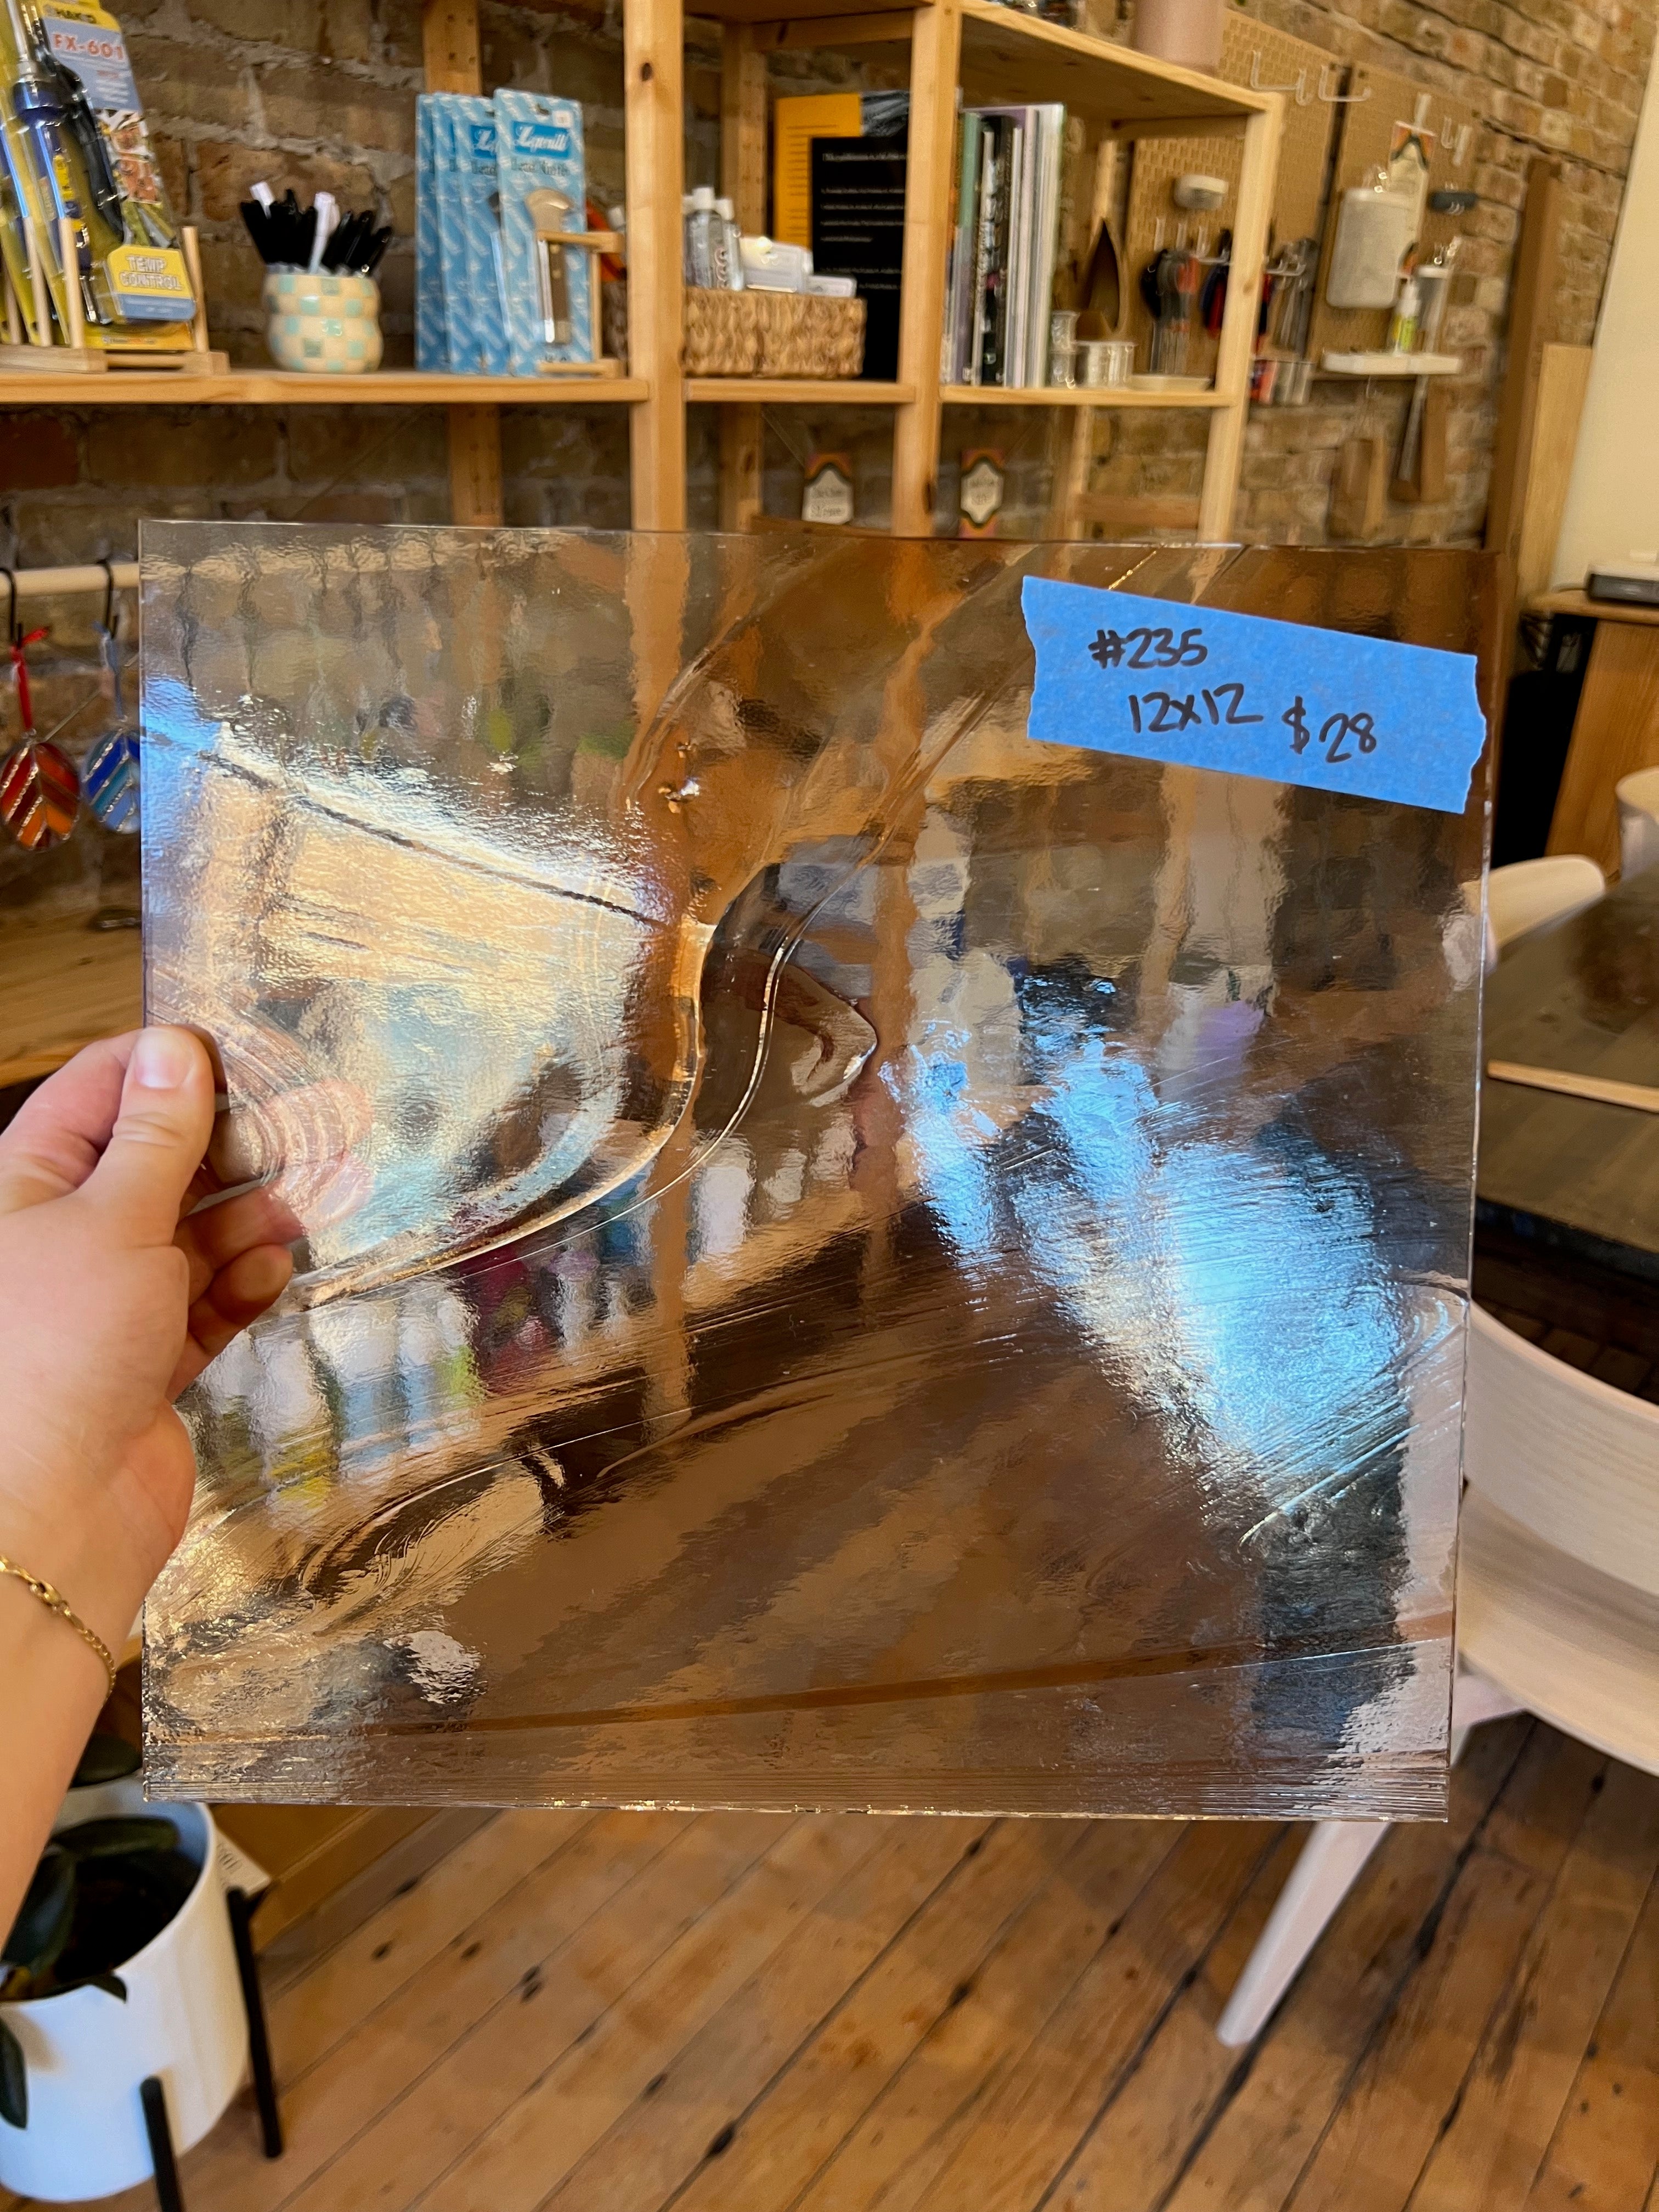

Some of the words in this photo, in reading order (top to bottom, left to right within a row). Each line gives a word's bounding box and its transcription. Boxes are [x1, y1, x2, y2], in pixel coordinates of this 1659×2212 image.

[53, 33, 125, 61] FX-601
[126, 255, 166, 272] TEMP
[120, 271, 183, 291] CONTROL
[1088, 628, 1207, 669] #235
